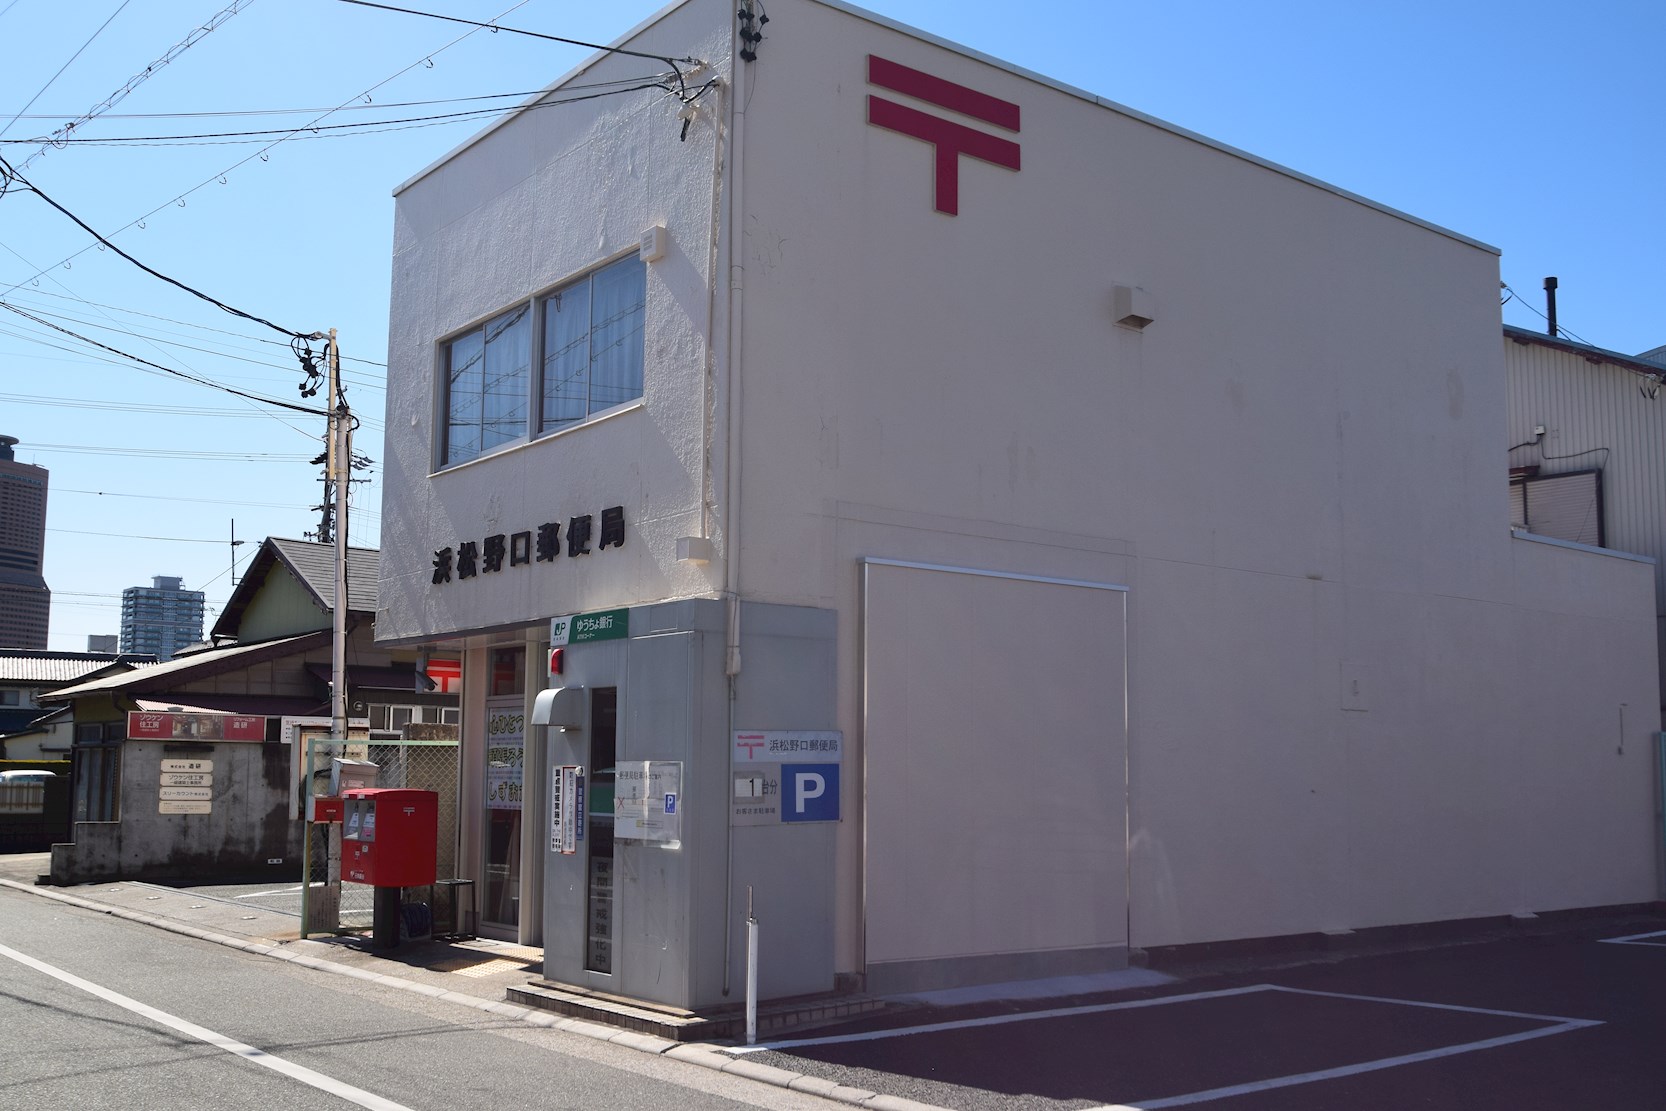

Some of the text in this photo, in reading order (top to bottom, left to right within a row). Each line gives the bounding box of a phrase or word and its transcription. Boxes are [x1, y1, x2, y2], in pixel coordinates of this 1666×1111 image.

[431, 505, 625, 585] 浜松野口郵便局
[576, 615, 613, 632] ゆうちょ銀行
[139, 721, 160, 729] 住工房
[769, 739, 838, 752] 浜松野口郵便局
[795, 772, 826, 813] P
[736, 807, 776, 815] お客さま駐車場
[594, 861, 608, 966] 夜間警戒強化中
